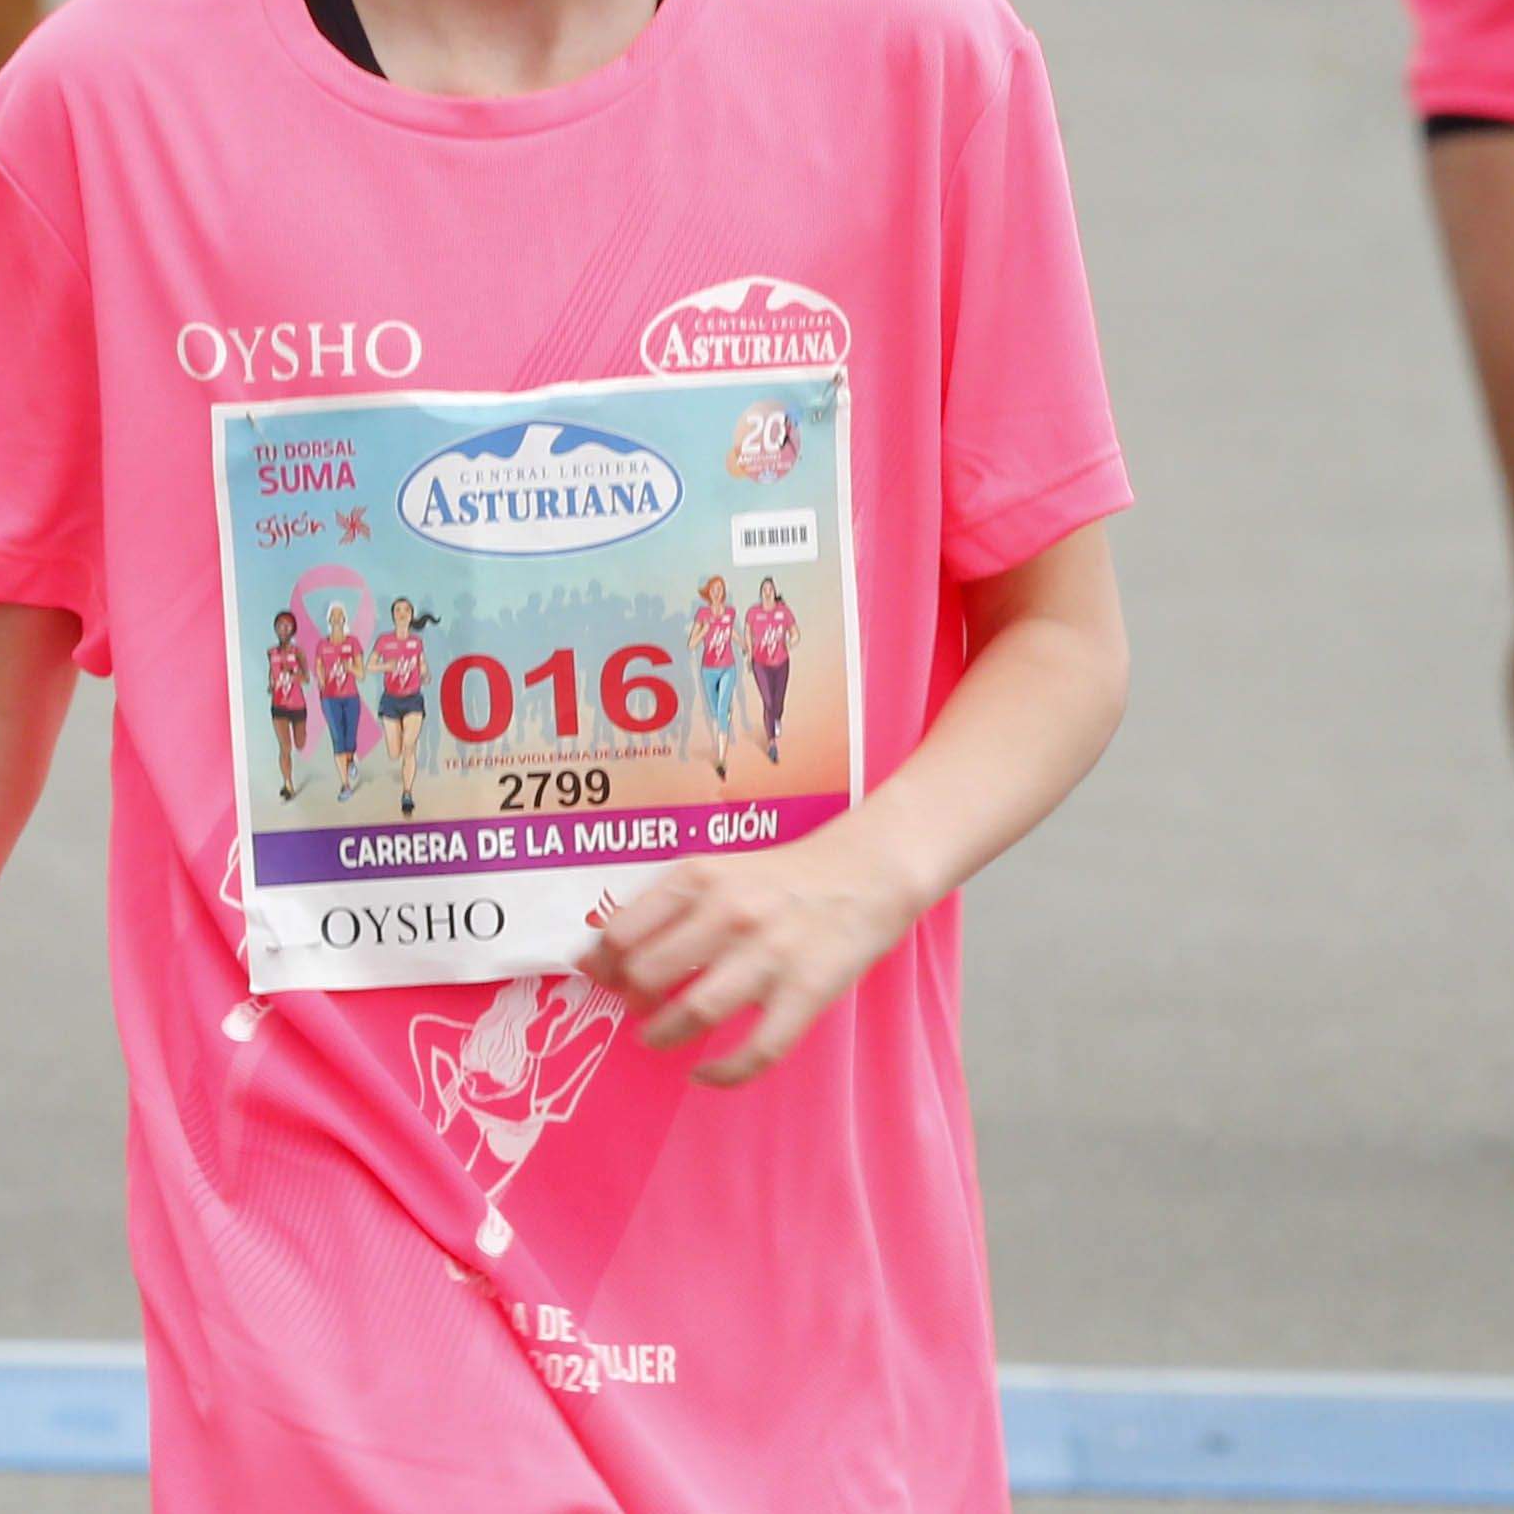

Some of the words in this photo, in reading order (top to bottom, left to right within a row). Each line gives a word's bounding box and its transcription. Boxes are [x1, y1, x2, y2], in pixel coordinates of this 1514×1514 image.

[661, 322, 836, 367] ASTURIANA
[694, 317, 765, 331] CENTRAL
[177, 320, 423, 383] OYSHO
[255, 443, 278, 462] TU
[284, 438, 356, 459] DORSAL
[741, 412, 787, 453] 20
[259, 461, 356, 496] SUMA
[460, 466, 549, 484] CENTRAL
[559, 461, 650, 479] LECHERA
[420, 476, 662, 527] ASTURIANA
[440, 644, 679, 743] 016
[498, 769, 611, 811] 2799
[339, 830, 467, 868] CARRERA
[478, 827, 516, 859] DE
[526, 824, 565, 856] LA
[575, 817, 678, 853] MUJER
[707, 802, 778, 845] GIJÓN
[320, 898, 505, 950] OYSHO
[537, 1303, 577, 1343] DE
